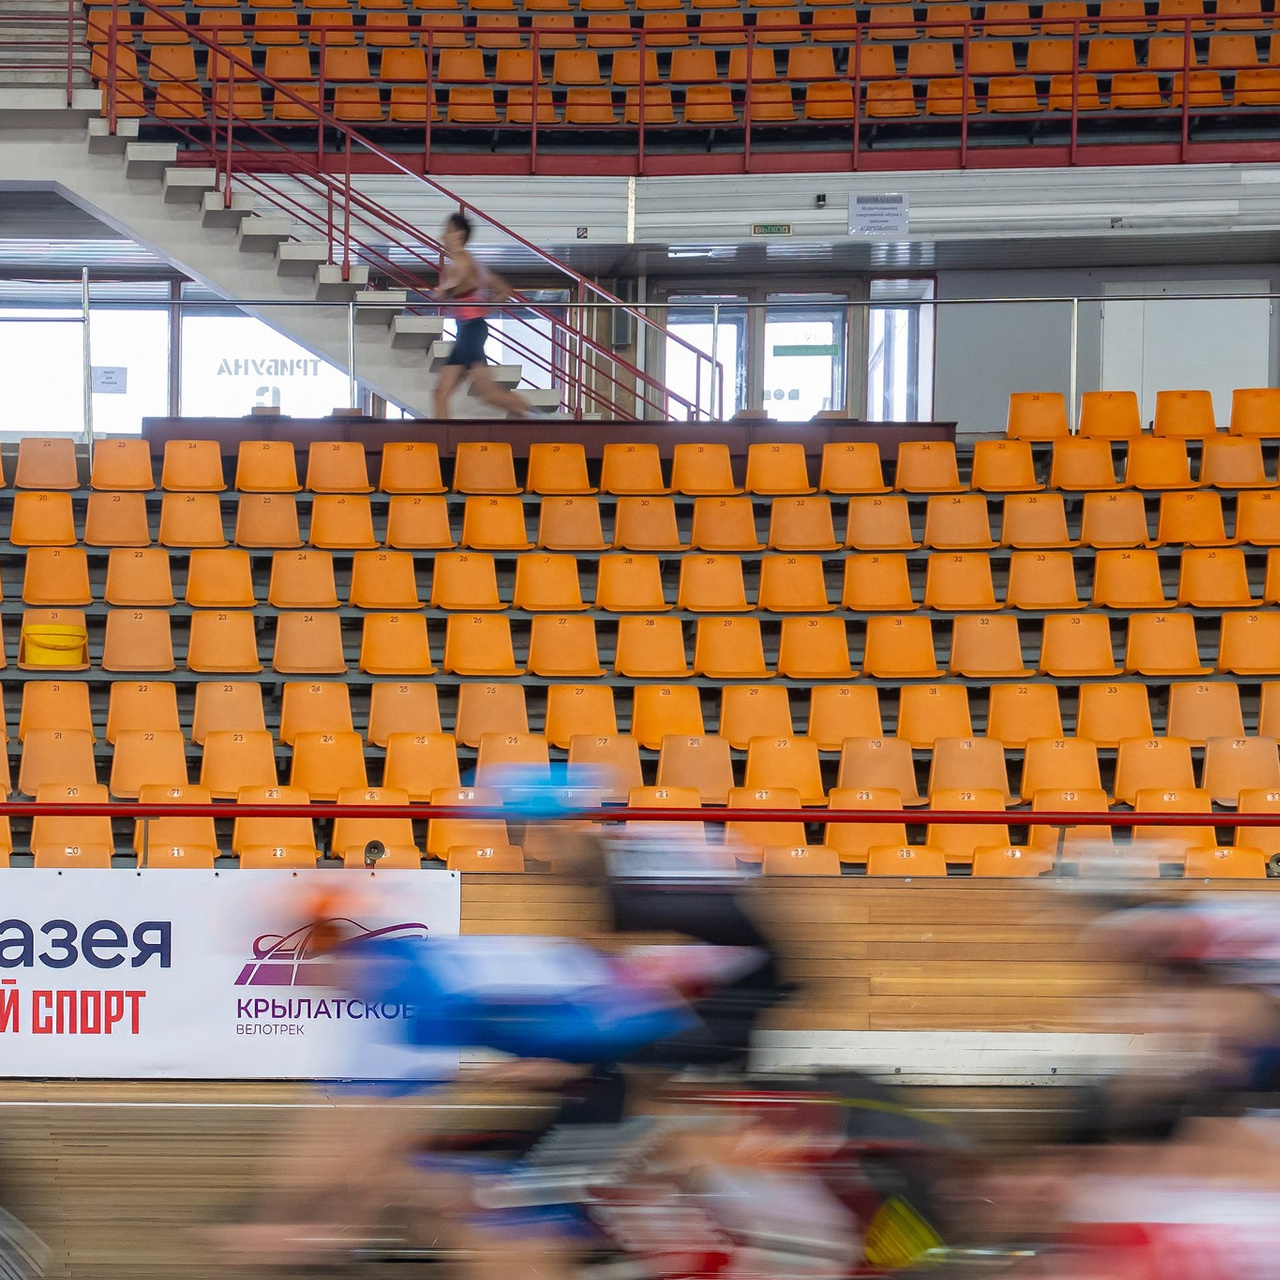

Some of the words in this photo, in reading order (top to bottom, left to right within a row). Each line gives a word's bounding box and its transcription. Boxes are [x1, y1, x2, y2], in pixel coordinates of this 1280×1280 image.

[754, 225, 790, 234] ВЫХОД
[32, 990, 146, 1035] СПОРТ
[236, 998, 415, 1020] КРЫЛАТСКОЕ
[236, 1024, 305, 1036] ВЕЛОТРЕК
